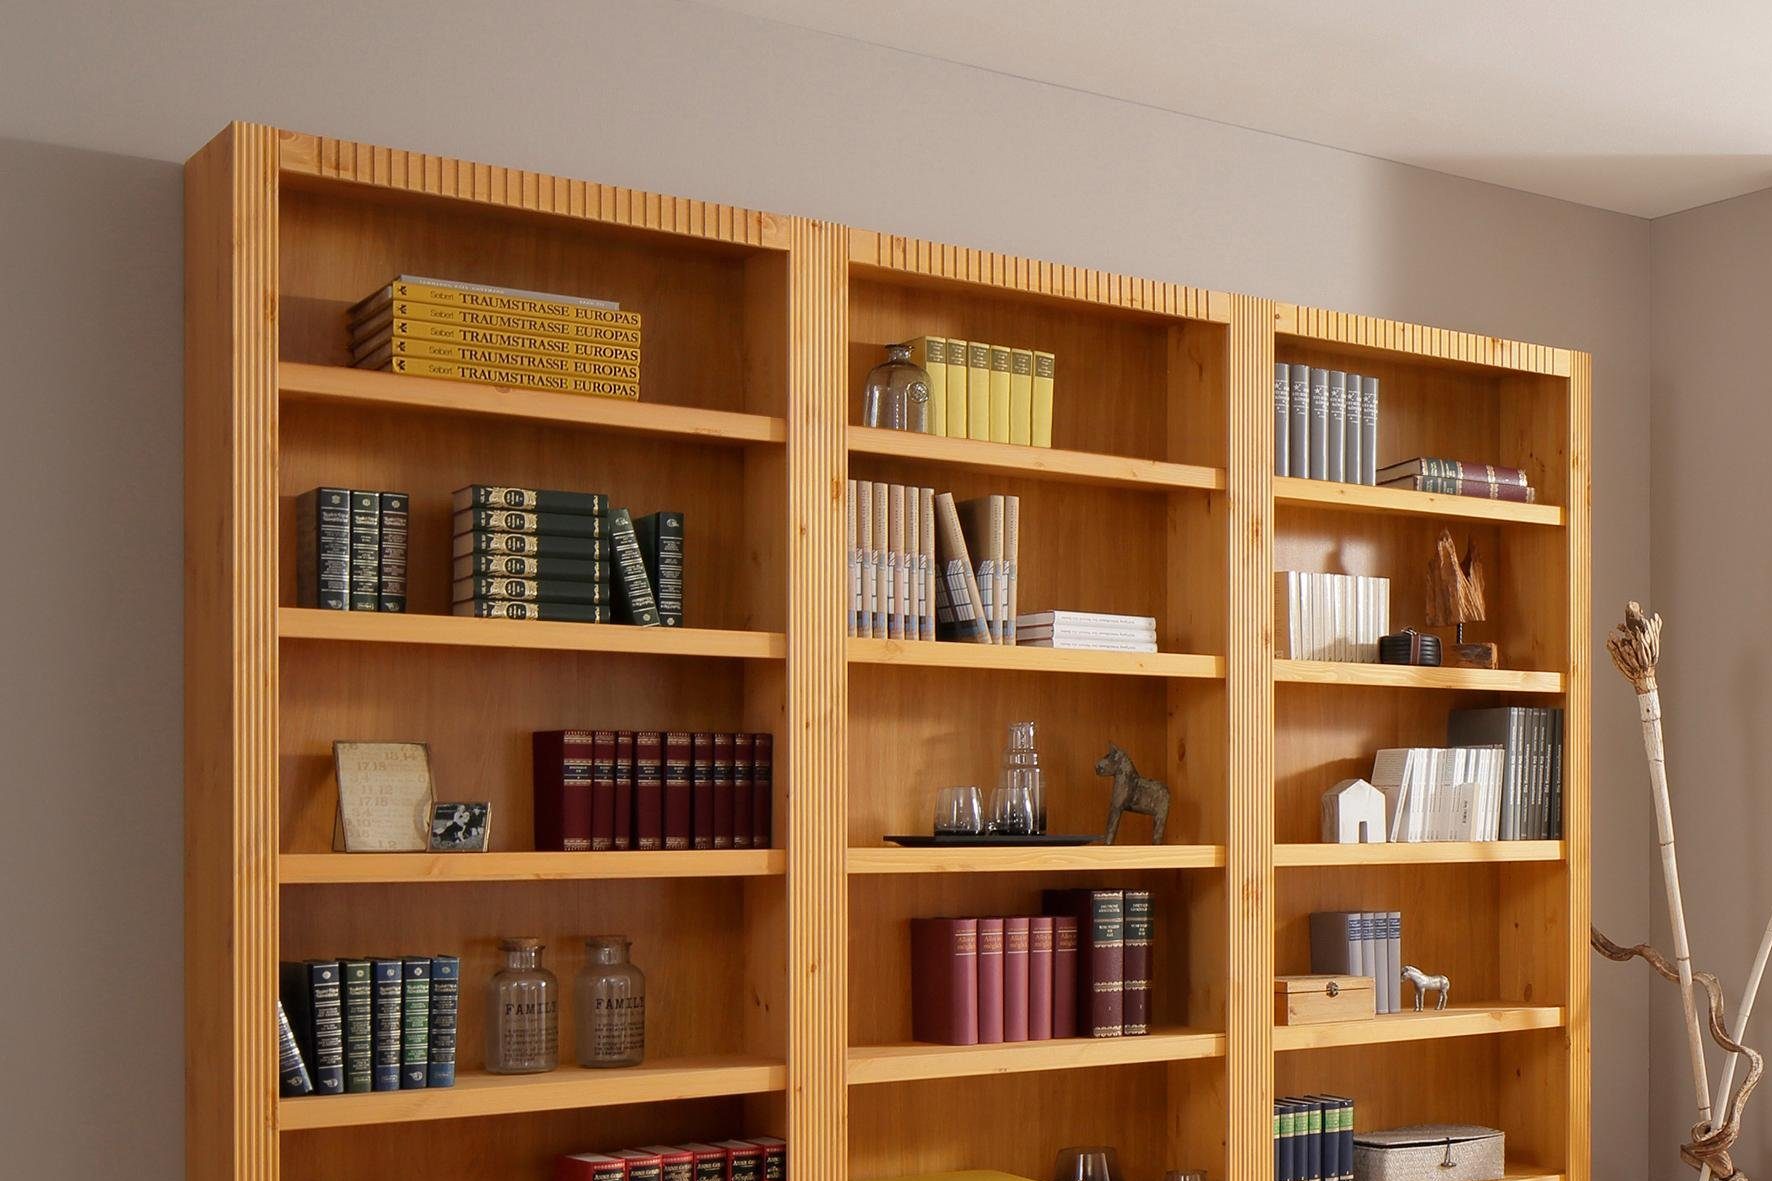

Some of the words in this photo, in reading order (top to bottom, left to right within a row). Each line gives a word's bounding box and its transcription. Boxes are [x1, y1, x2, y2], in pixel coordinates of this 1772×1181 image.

[459, 293, 569, 316] TRAUMSTRASSE
[575, 308, 638, 326] EUROPAS
[459, 311, 570, 334] TRAUMSTRASSE
[575, 326, 638, 342] EUROPAS
[459, 329, 570, 353] TRAUMSTRASSE
[575, 344, 638, 362] EUROPAS
[458, 348, 568, 371] TRAUMSTRASSE
[574, 362, 637, 379] EUROPAS
[458, 366, 568, 389] TRAUMSTRASSE
[574, 379, 637, 396] EUROPAS
